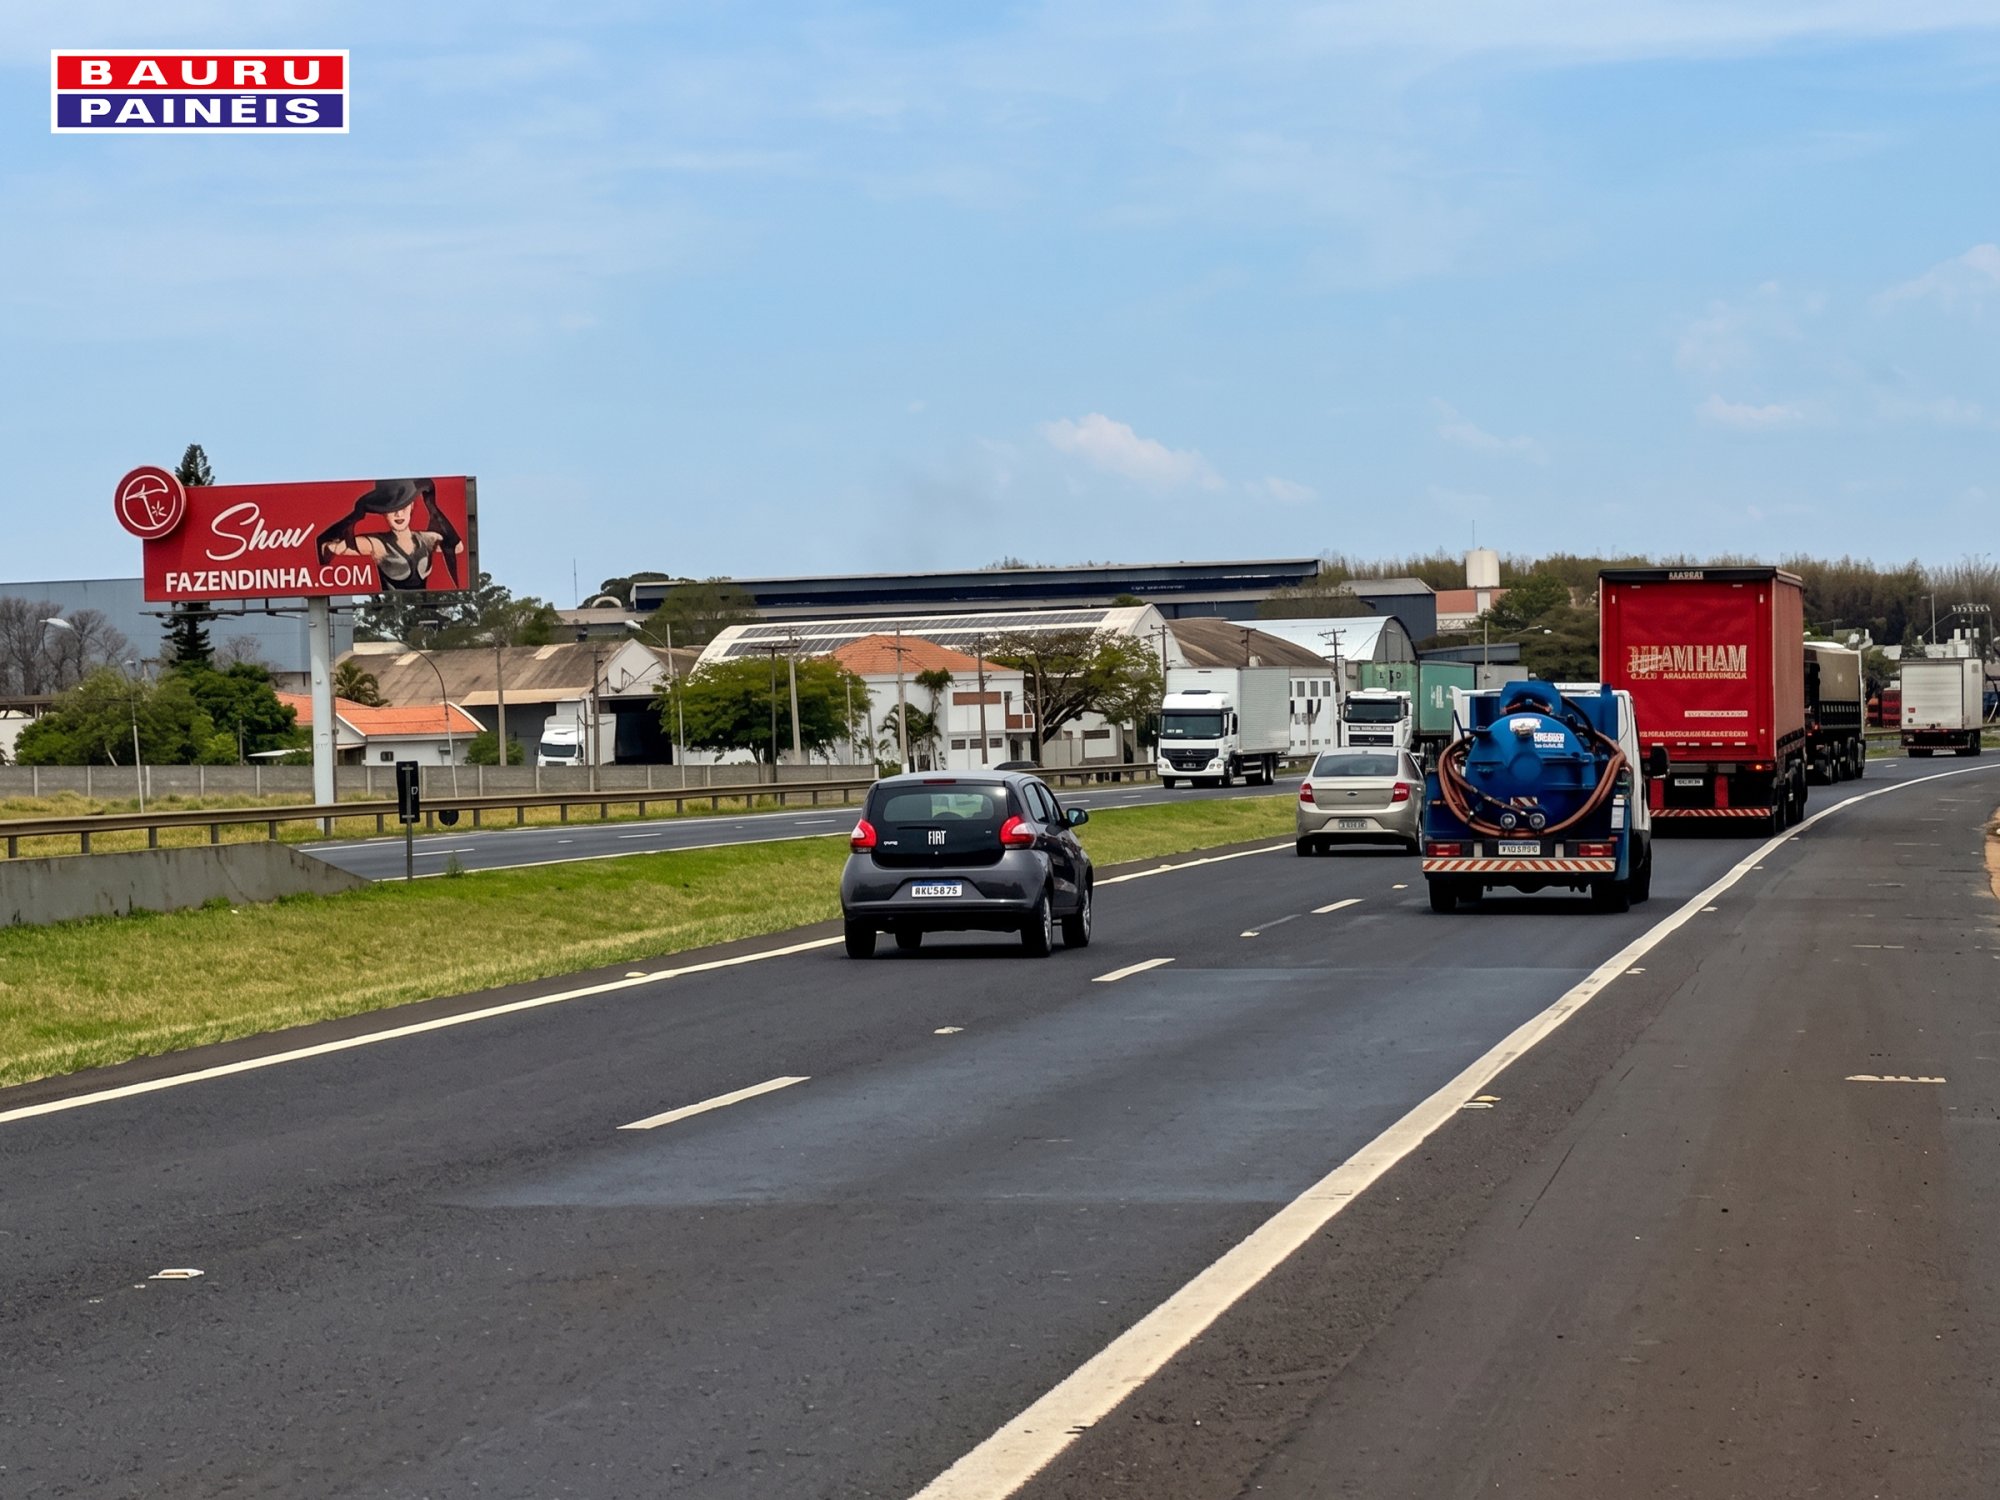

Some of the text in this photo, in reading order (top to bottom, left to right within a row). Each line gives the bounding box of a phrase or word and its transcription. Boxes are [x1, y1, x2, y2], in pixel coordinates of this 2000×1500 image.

[205, 502, 315, 561] Show
[165, 565, 373, 593] FAZENDINHA.COM
[927, 830, 947, 846] FIAT
